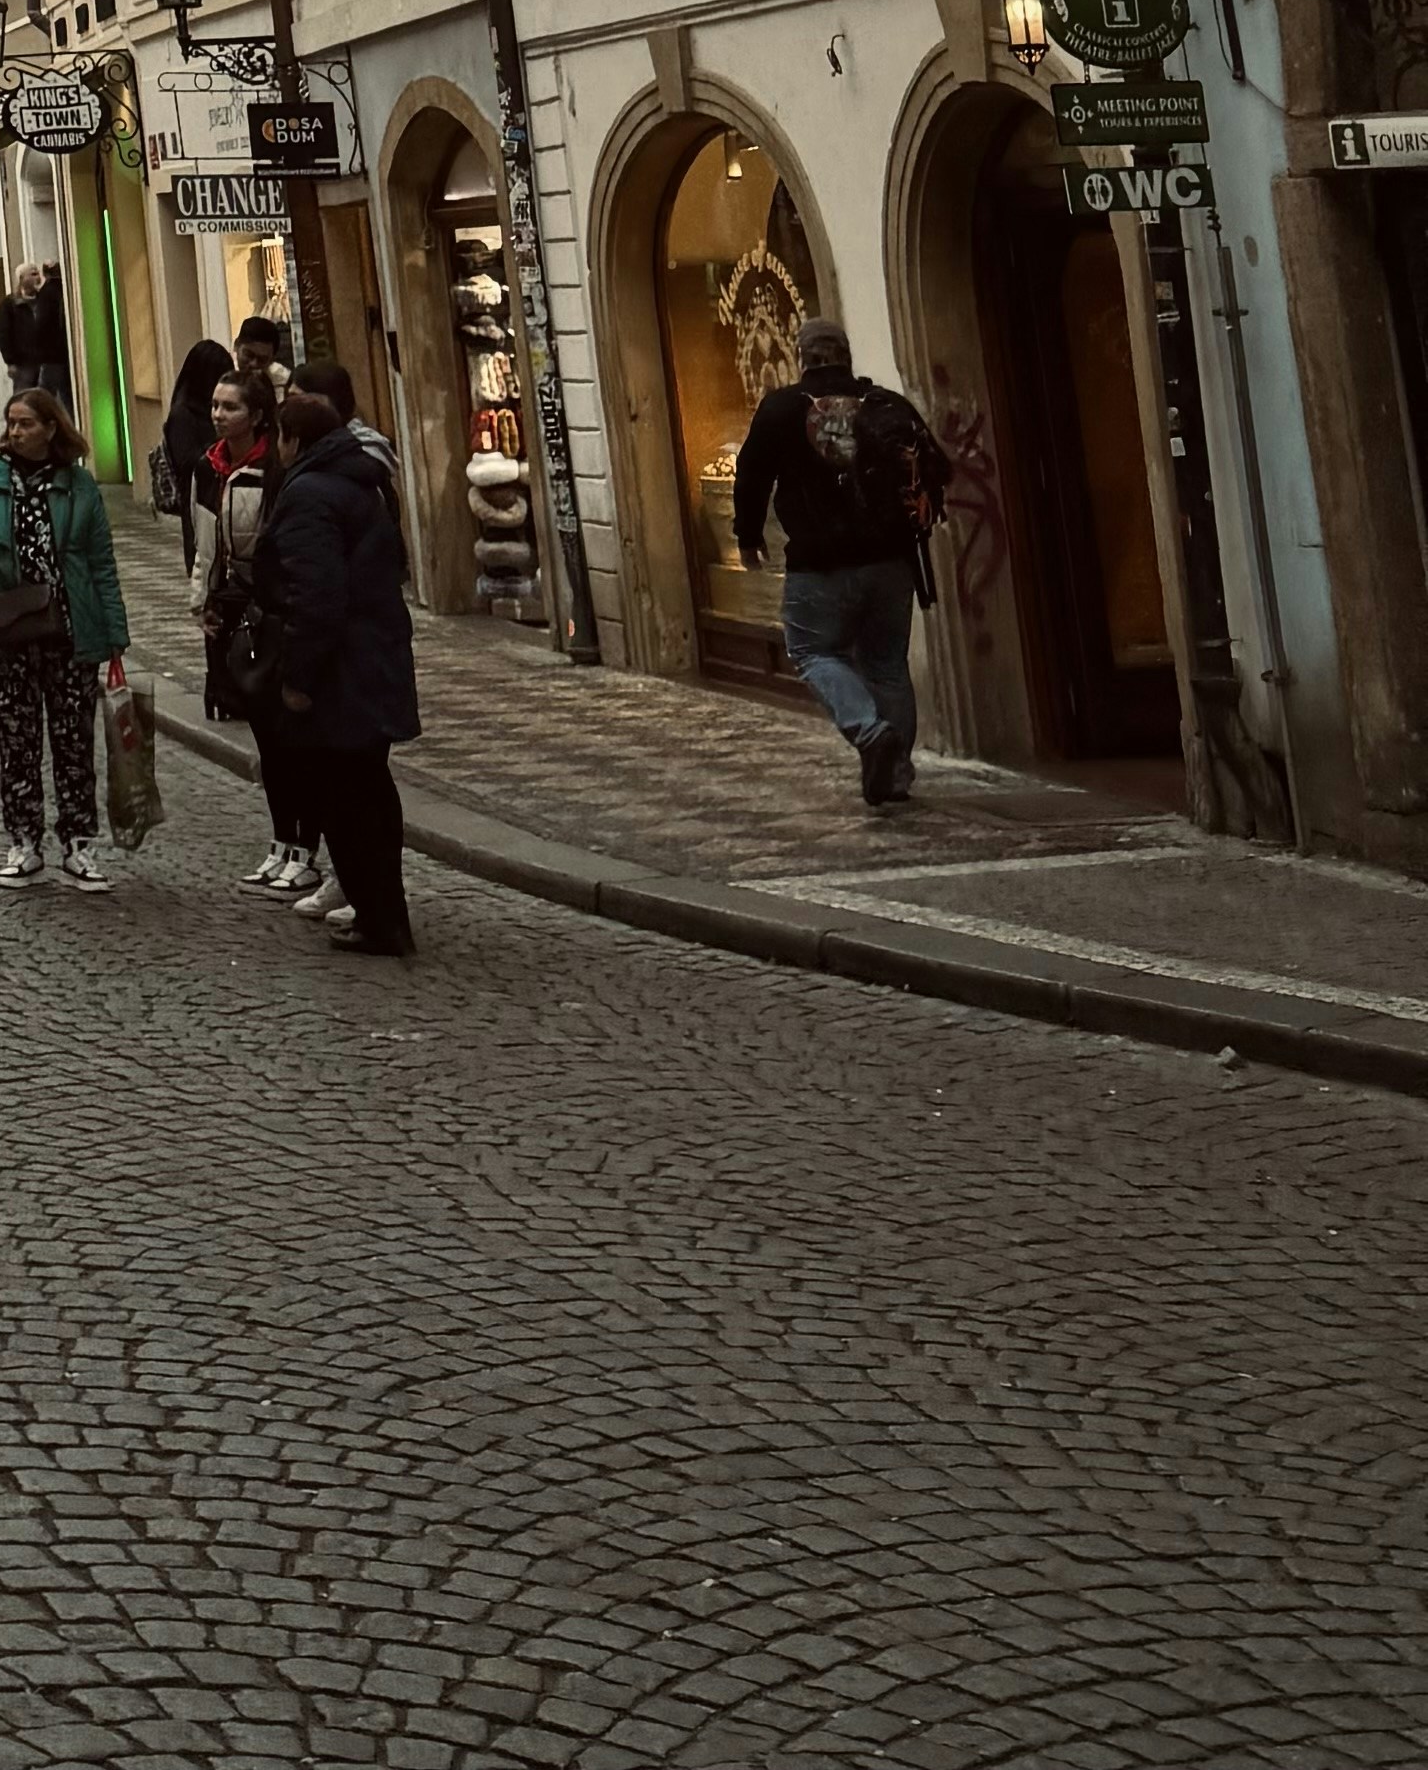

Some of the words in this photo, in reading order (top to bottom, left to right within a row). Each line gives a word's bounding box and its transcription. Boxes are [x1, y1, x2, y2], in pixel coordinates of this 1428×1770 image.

[29, 87, 79, 107] KING'S
[1097, 99, 1156, 113] MEETING
[1159, 98, 1199, 112] POINT
[32, 109, 82, 128] TOWN
[275, 117, 323, 131] DOSA
[33, 132, 86, 147] CANNABIS
[277, 130, 315, 143] DUM
[1119, 167, 1202, 209] WC
[177, 178, 285, 216] CHANGE
[197, 219, 289, 233] COMMISSION
